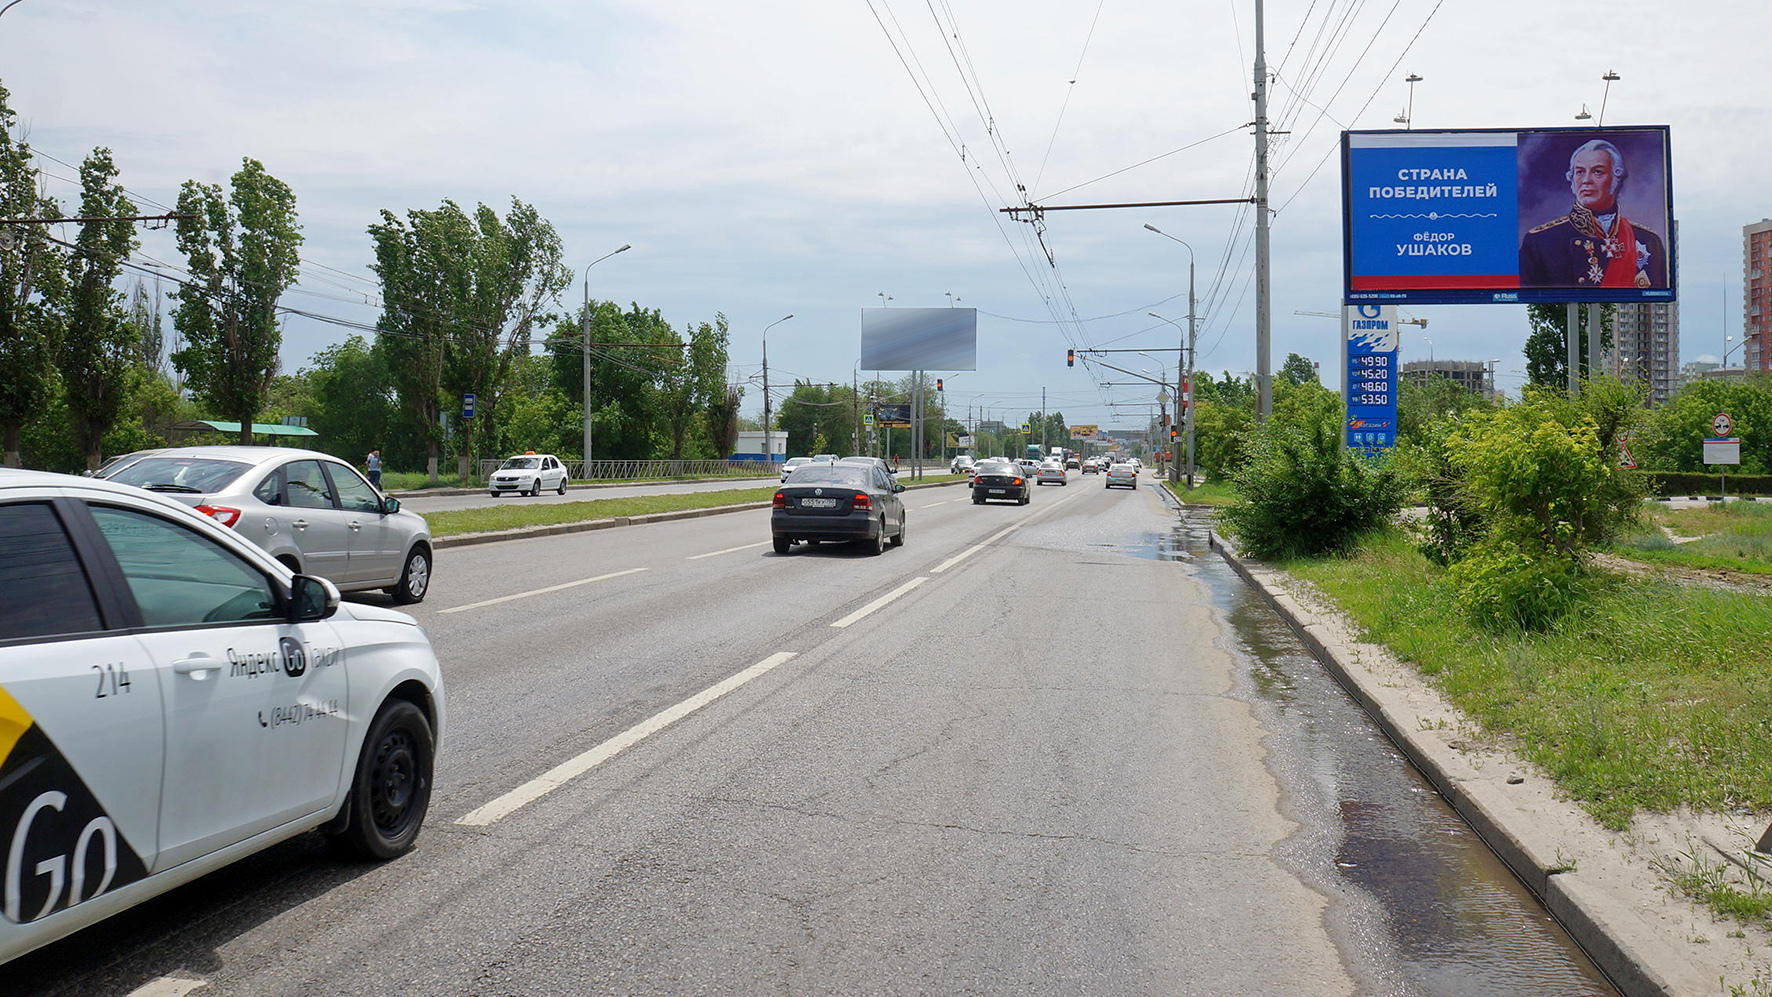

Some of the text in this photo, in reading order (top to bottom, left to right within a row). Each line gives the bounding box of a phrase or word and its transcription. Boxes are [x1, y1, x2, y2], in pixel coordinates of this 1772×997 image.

[1397, 168, 1468, 180] СТРАНА
[1369, 182, 1497, 200] ПОБЕДИТЕЛЕЙ
[1413, 231, 1455, 242] ФЁДОР
[1396, 243, 1472, 256] УШАКОВ
[1352, 320, 1389, 330] ГАЗПРОМ
[1361, 369, 1388, 379] 45.20
[1361, 381, 1388, 392] 48.60
[1361, 394, 1388, 405] 53.50
[226, 640, 340, 679] Яндекс Go Такси
[91, 661, 131, 698] 214
[270, 703, 302, 730] (8442)
[4, 789, 118, 925] Go
